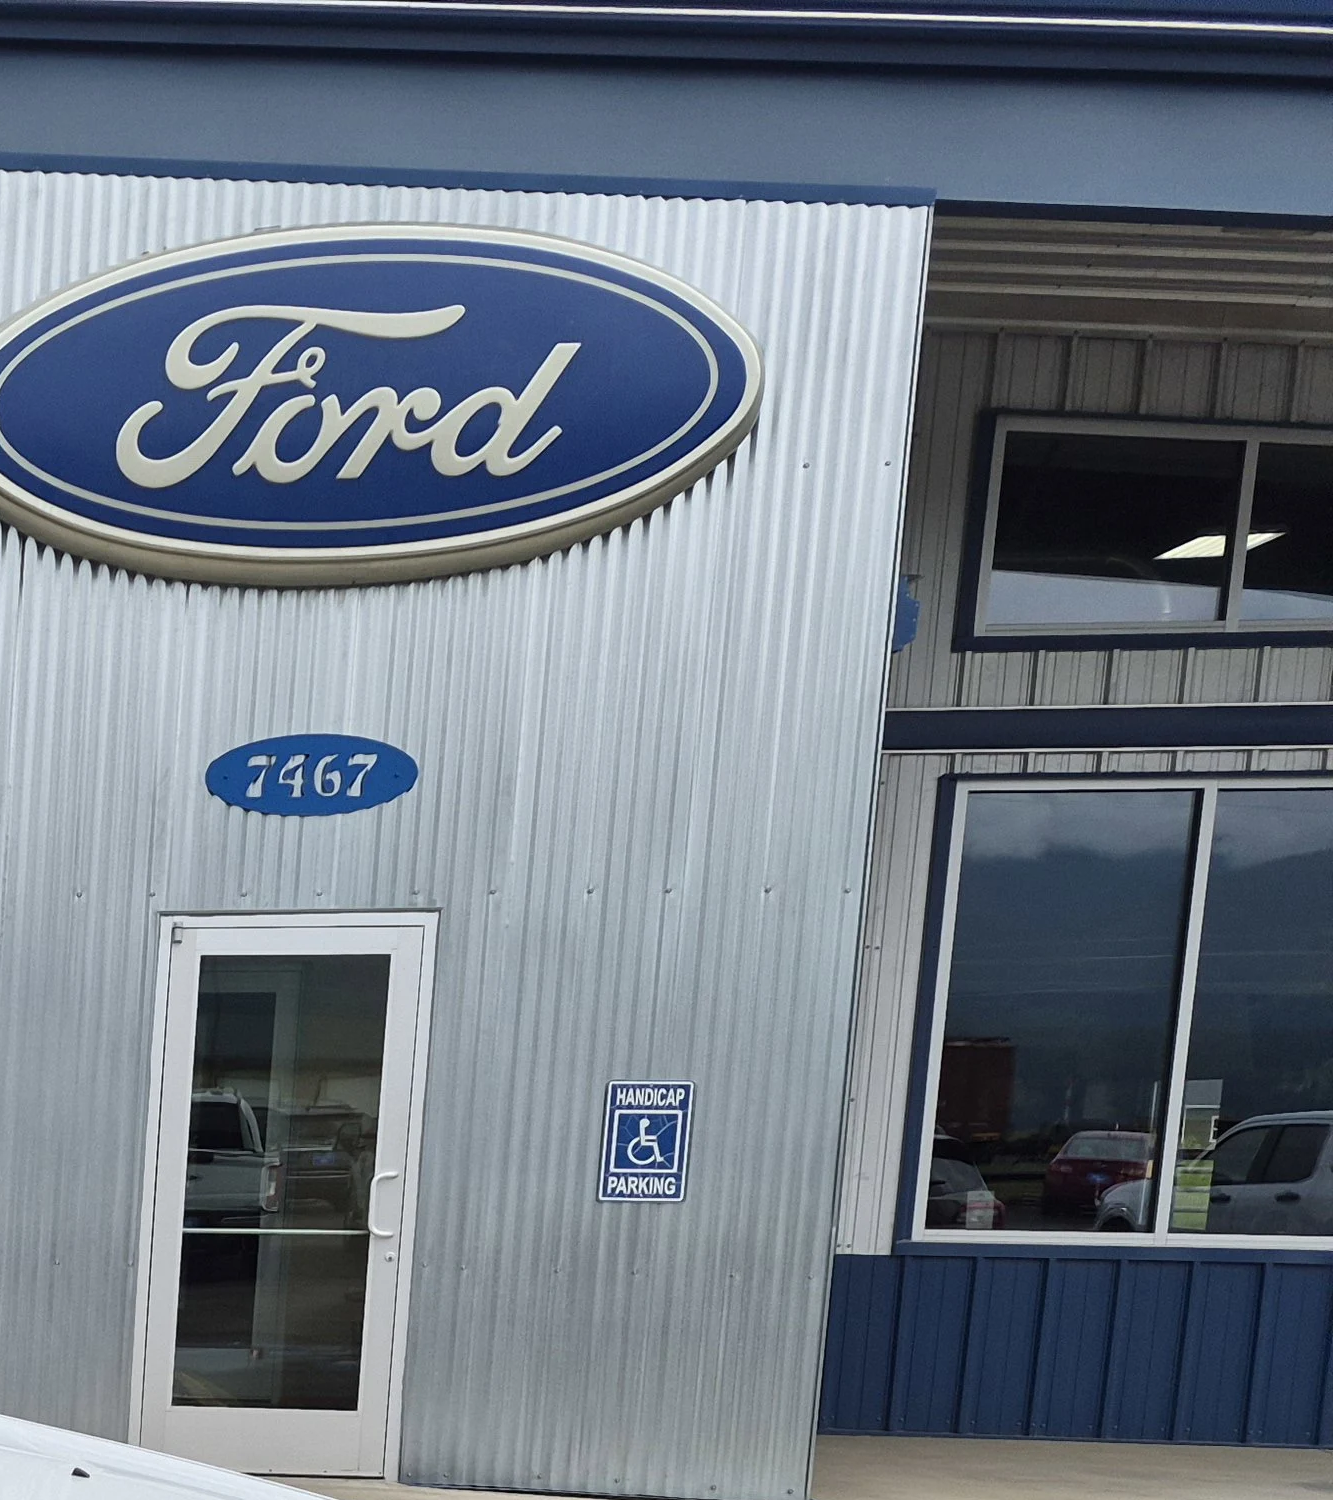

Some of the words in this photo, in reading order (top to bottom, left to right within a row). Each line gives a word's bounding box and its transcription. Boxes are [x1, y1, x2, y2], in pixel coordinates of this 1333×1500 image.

[116, 304, 581, 488] Ford
[245, 753, 378, 798] 7467
[616, 1087, 685, 1106] HANDICAP
[607, 1176, 676, 1195] PARKING
